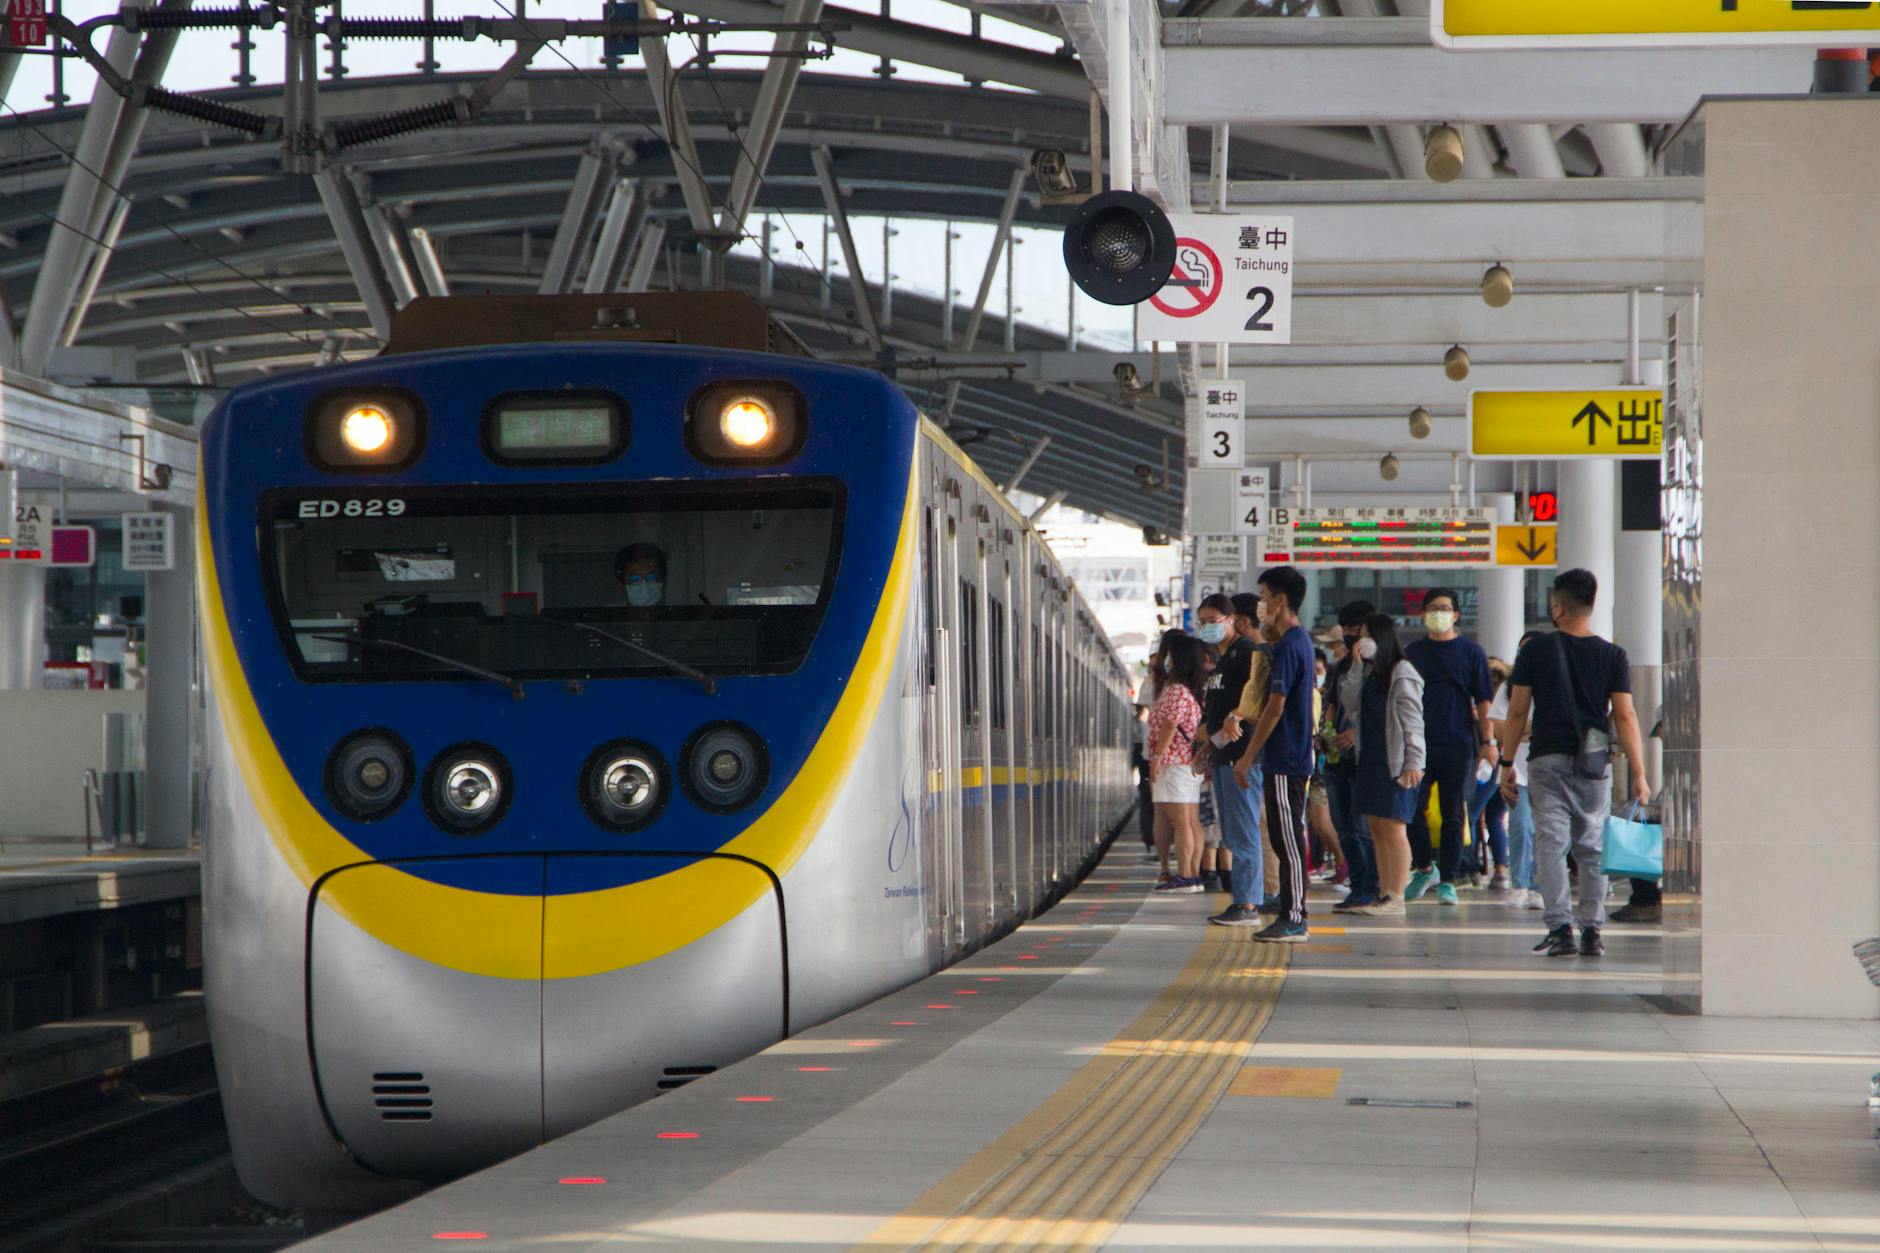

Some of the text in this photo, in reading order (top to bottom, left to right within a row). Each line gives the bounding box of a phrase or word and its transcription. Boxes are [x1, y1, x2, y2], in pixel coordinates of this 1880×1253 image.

[19, 23, 38, 42] 10
[1238, 226, 1287, 250] 臺中
[1235, 257, 1288, 274] Taichung
[1244, 286, 1275, 331] 2
[1206, 390, 1238, 406] 臺中
[1205, 411, 1239, 419] Taichung
[1213, 431, 1231, 458] 3
[1240, 475, 1265, 488] 臺中
[16, 505, 41, 522] 2A
[298, 498, 406, 518] ED829
[1244, 507, 1259, 527] 4
